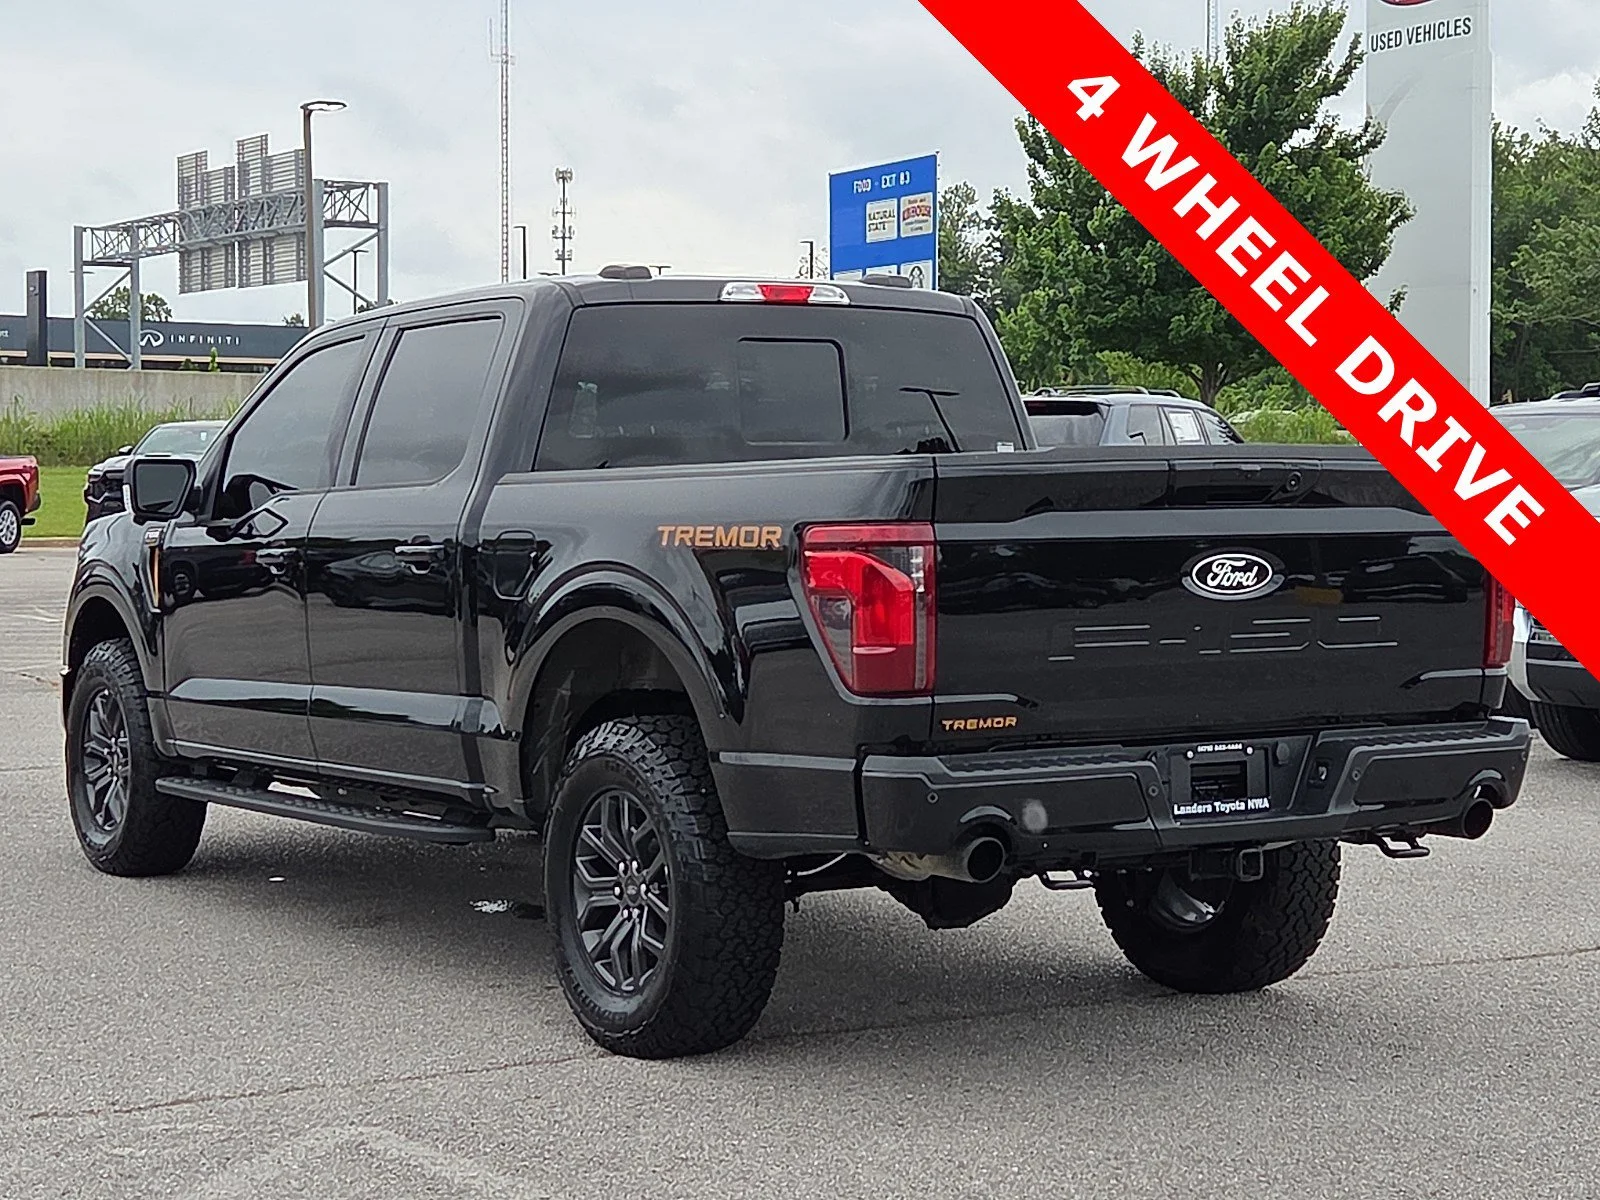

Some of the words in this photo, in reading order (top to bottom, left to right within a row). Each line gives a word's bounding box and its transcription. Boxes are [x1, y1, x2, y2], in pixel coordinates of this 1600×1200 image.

[1370, 30, 1402, 52] USED
[1406, 17, 1471, 45] VEHICLES
[868, 223, 887, 232] STATE
[169, 334, 241, 346] INFINITI
[657, 525, 782, 548] TREMOR
[1206, 559, 1258, 587] Ford
[941, 716, 1017, 731] TREMOR
[1173, 803, 1212, 815] Landers
[1214, 801, 1246, 813] Toyota
